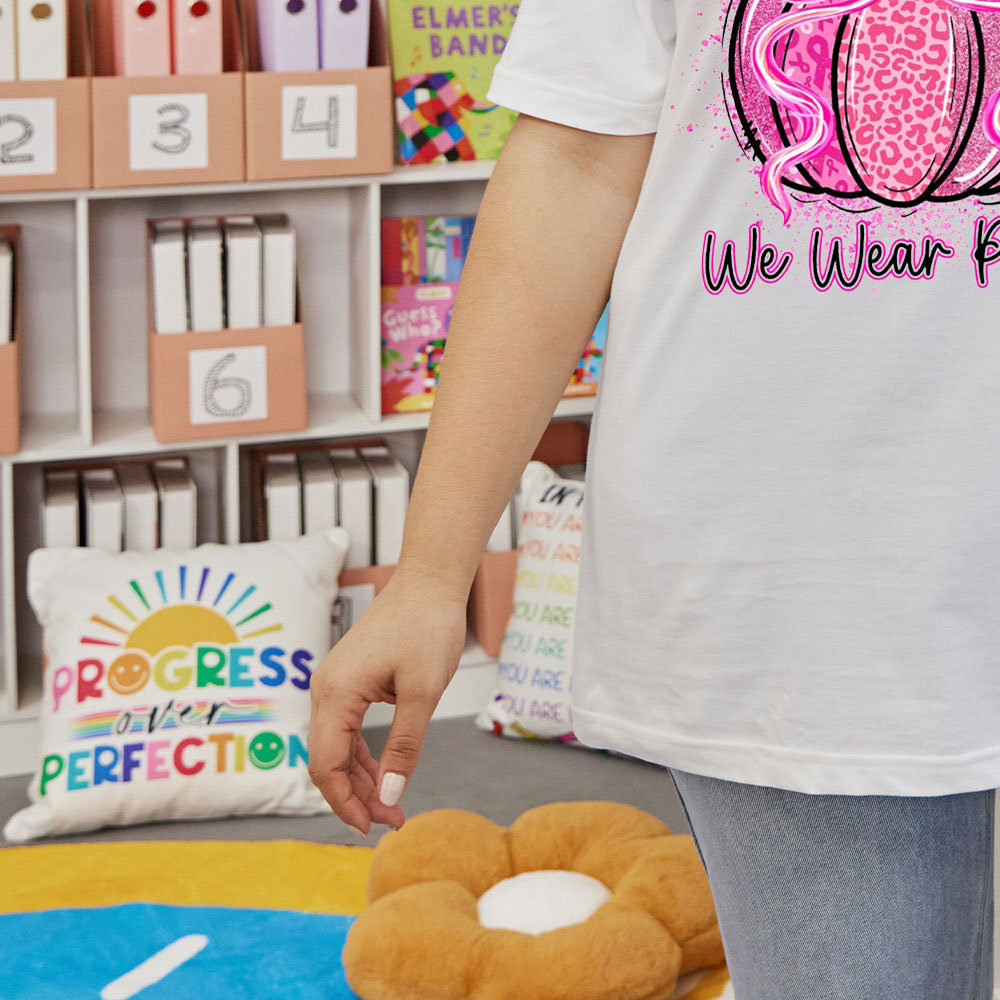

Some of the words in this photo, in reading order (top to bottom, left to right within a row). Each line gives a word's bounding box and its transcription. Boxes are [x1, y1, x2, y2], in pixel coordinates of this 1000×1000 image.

[430, 34, 507, 59] BAND
[0, 114, 34, 164] 2
[152, 103, 192, 154] 3
[291, 95, 339, 148] 4
[702, 222, 792, 294] We
[809, 221, 955, 291] Wear
[383, 306, 437, 328] Guess
[388, 318, 442, 343] Who?
[204, 353, 251, 417] 6
[540, 605, 573, 628] ARE
[535, 637, 568, 660] ARE
[52, 646, 314, 712] PROGRESS
[530, 668, 564, 691] ARE
[115, 699, 250, 735] over
[529, 699, 562, 721] ARE
[39, 731, 310, 797] PERFECTION
